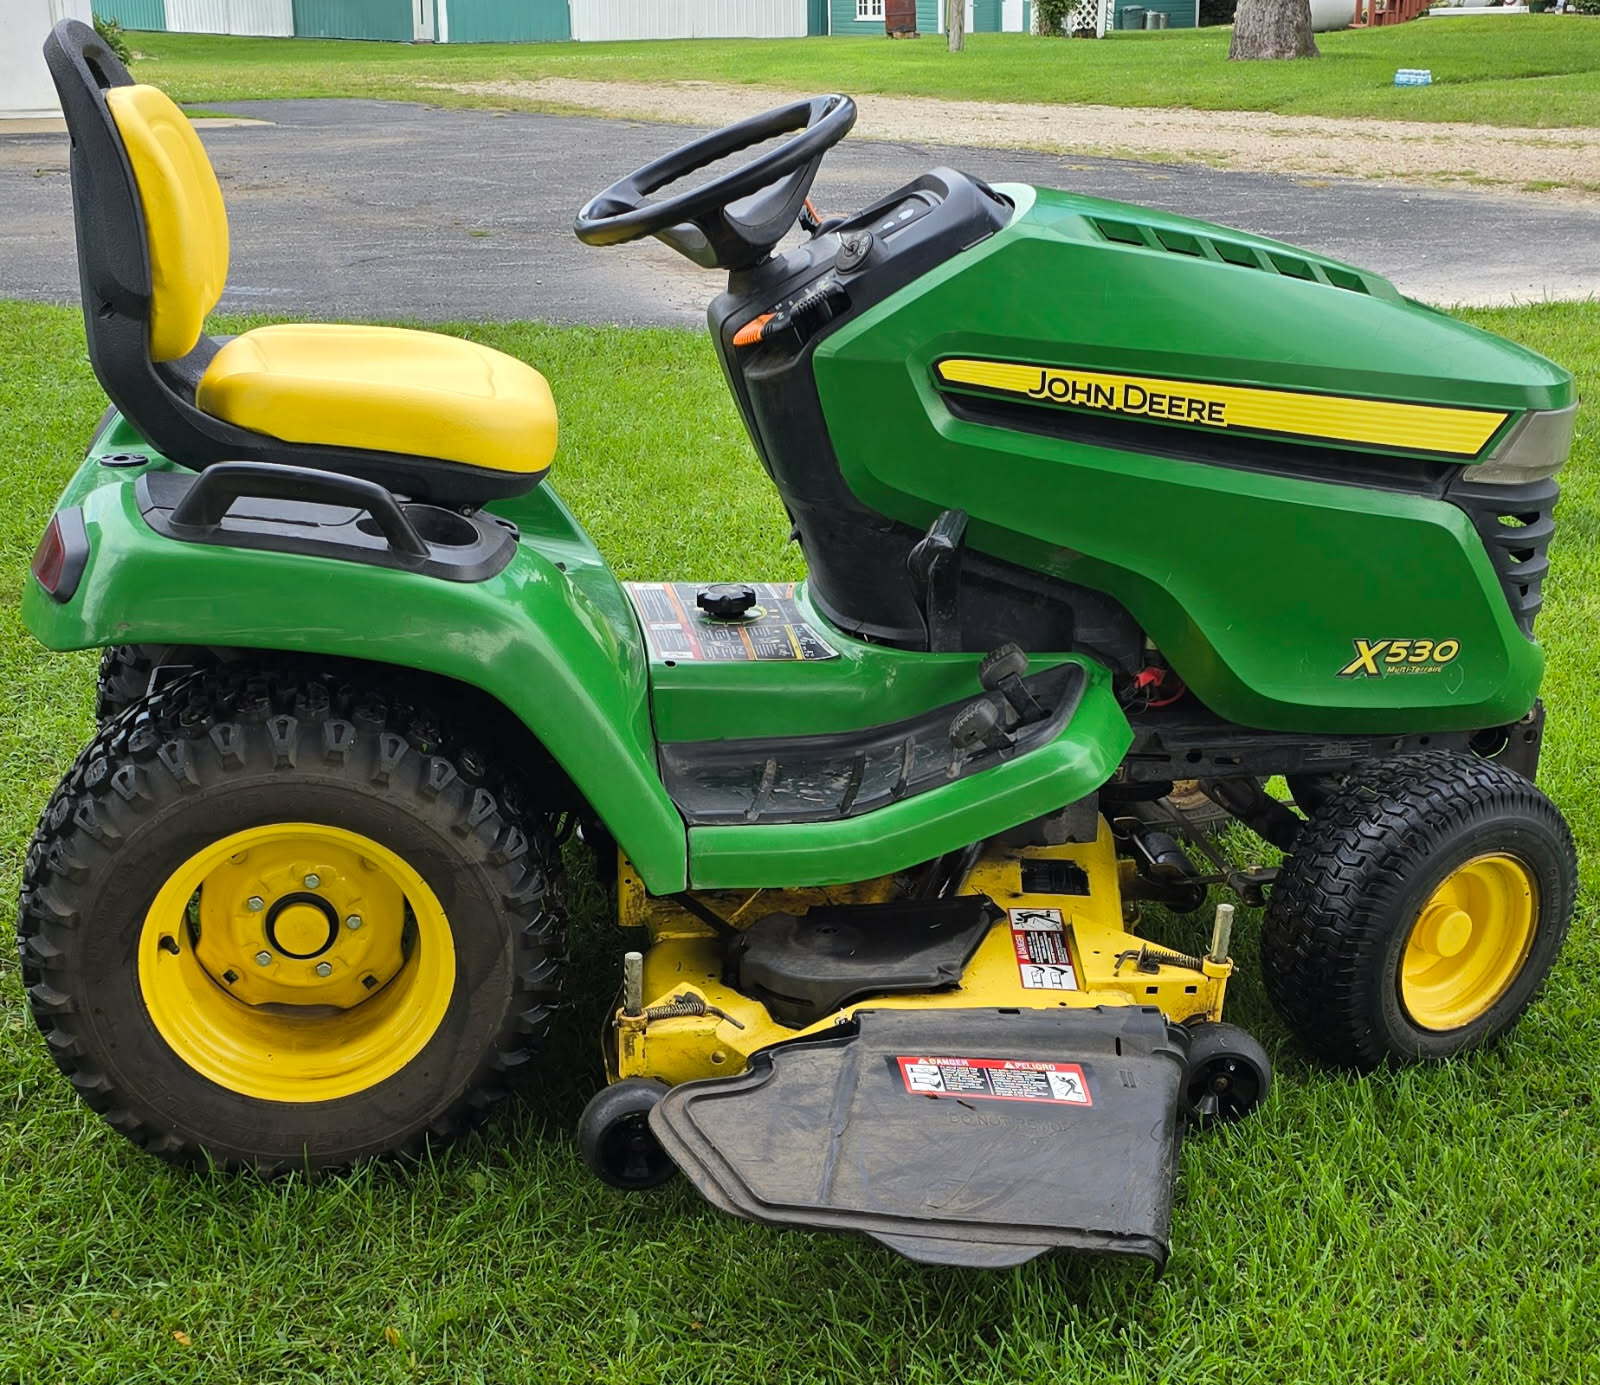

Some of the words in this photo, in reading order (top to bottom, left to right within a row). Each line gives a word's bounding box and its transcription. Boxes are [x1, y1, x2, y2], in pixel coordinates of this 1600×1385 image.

[1028, 370, 1115, 407] JOHN
[1123, 383, 1227, 423] DEERE
[1337, 639, 1460, 676] X530
[929, 1057, 969, 1067] DANGER
[1015, 1062, 1055, 1072] PELIGRO
